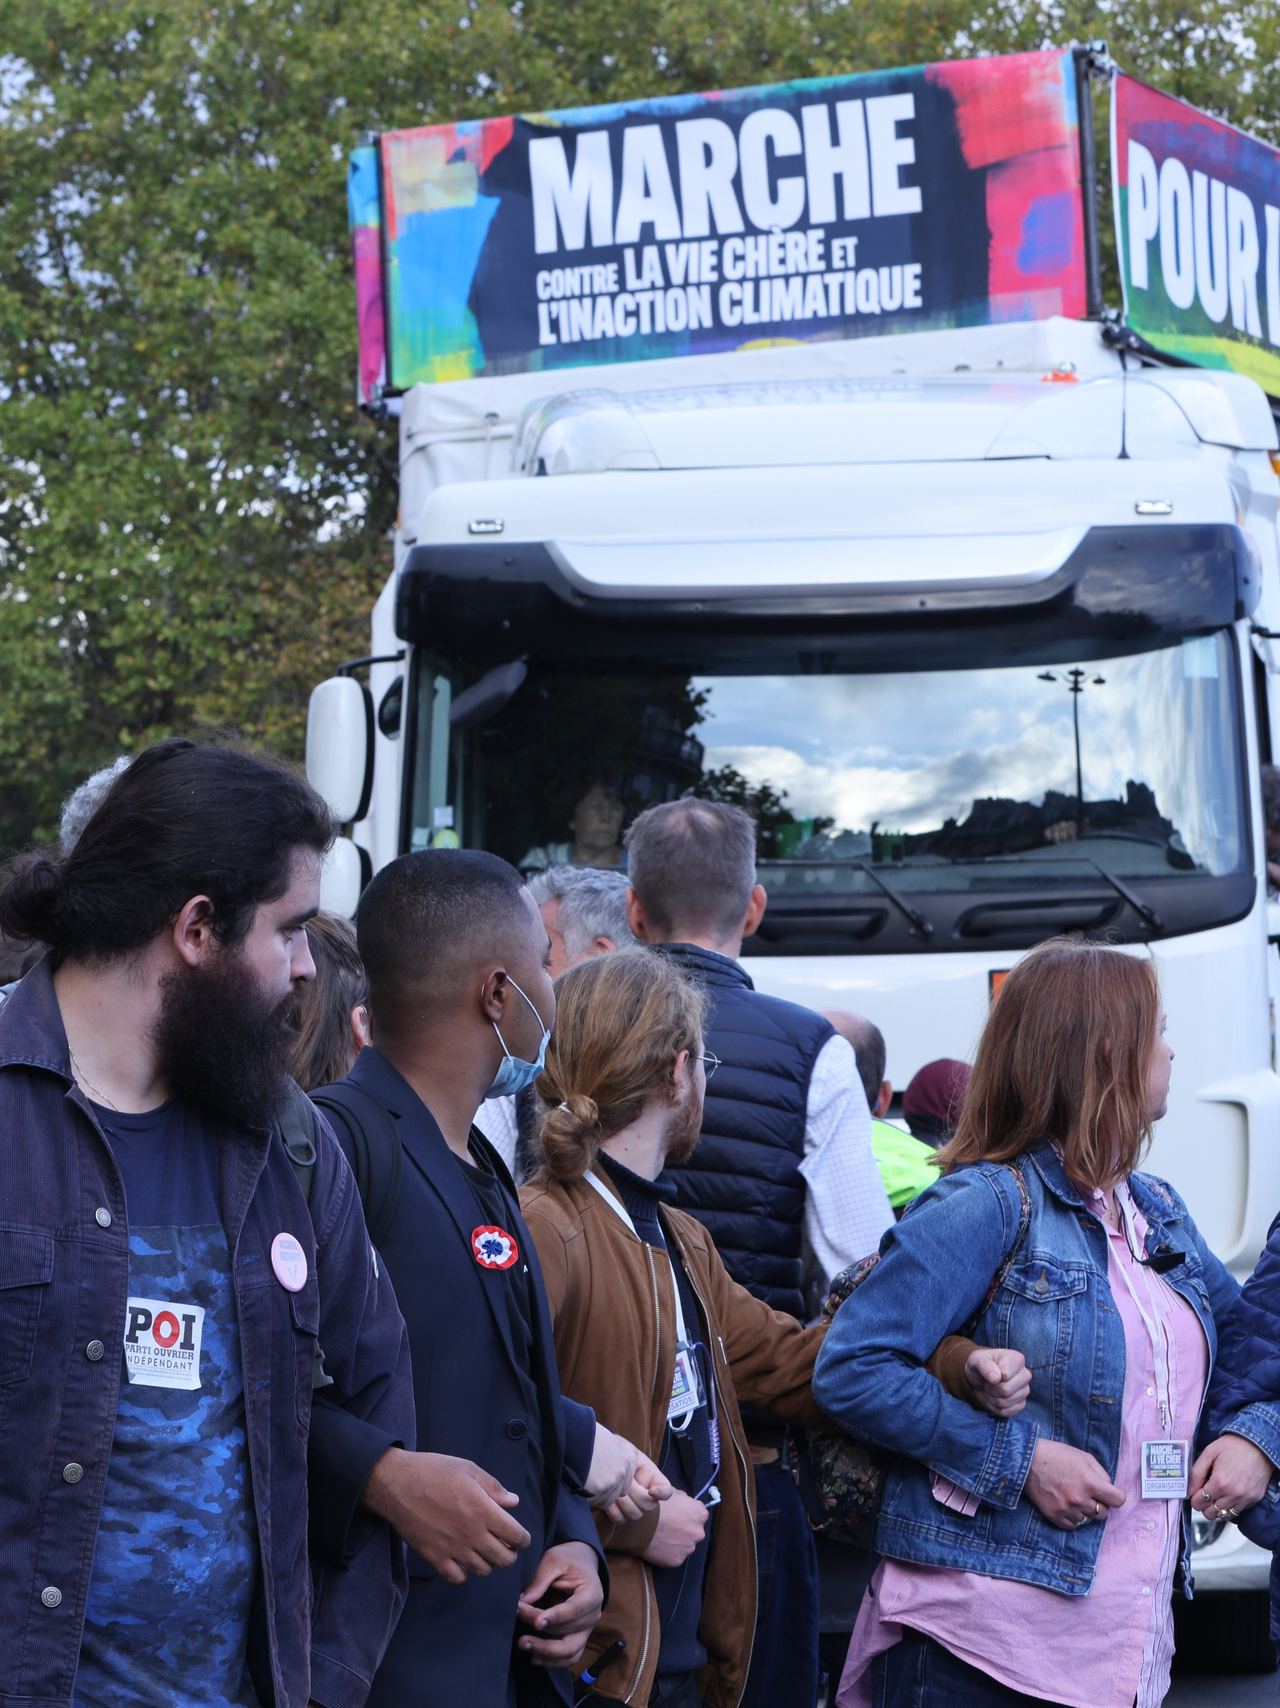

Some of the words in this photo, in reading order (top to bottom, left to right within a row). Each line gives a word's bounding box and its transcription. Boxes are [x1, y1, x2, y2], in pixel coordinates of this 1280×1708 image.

[528, 92, 923, 254] MARCHE
[1127, 137, 1263, 340] POUR
[536, 262, 620, 301] CONTRE
[623, 244, 665, 292] LA
[664, 239, 719, 286] VIE
[721, 226, 826, 281] CHÈRE
[831, 236, 859, 270] ET
[537, 284, 714, 346] L'INACTION
[718, 262, 924, 328] CLIMATIQUE
[125, 1306, 196, 1351] POI
[125, 1344, 151, 1354] PARTI
[154, 1347, 194, 1360] OUVRIER
[128, 1355, 192, 1370] NDÉPENDANT
[1150, 1444, 1173, 1454] MARCHE
[1146, 1482, 1185, 1490] ORGANISATION
